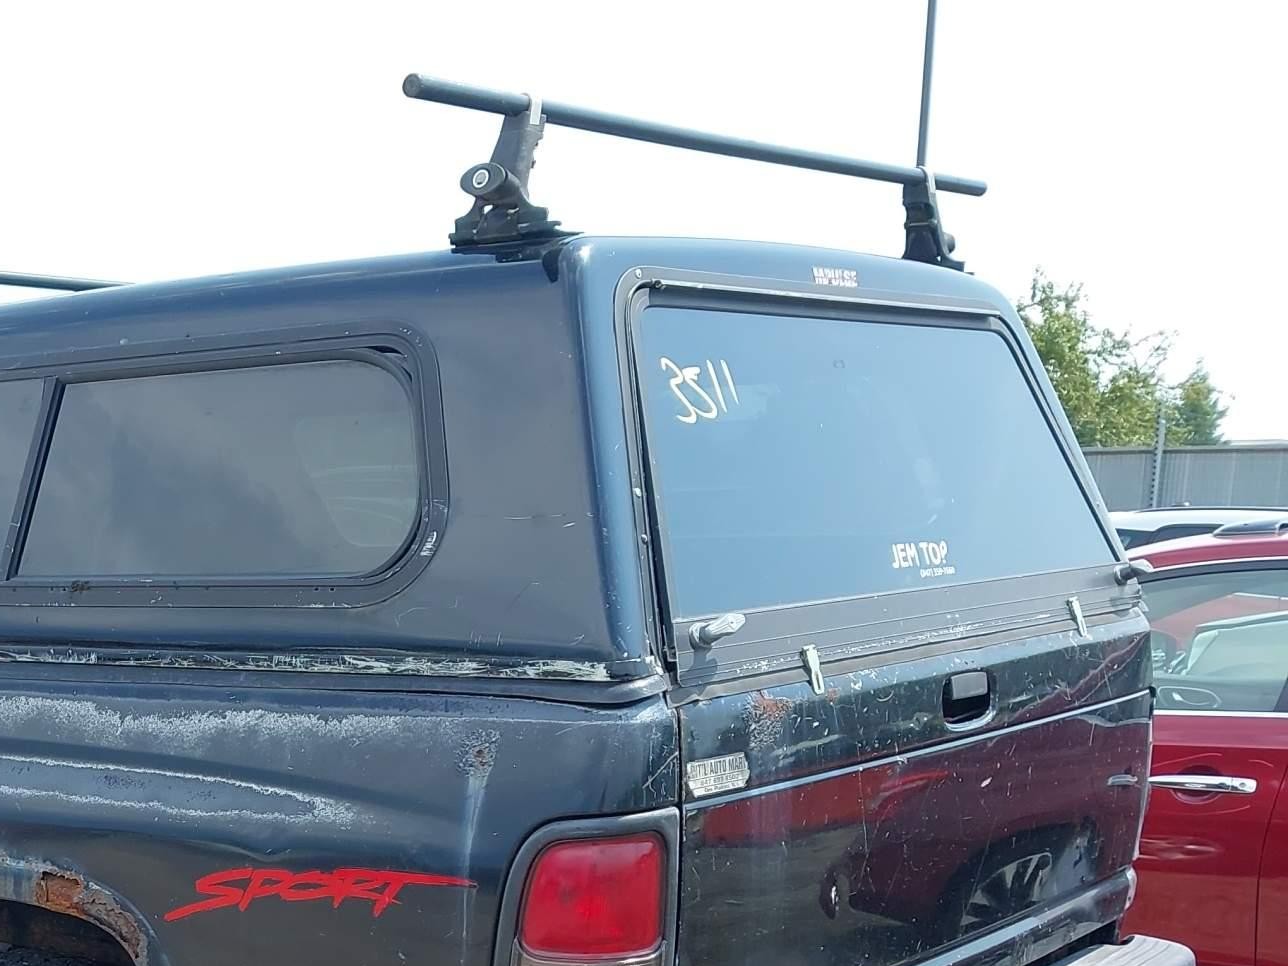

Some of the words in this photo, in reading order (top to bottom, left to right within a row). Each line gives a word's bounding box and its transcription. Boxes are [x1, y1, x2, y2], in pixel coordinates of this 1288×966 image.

[659, 356, 740, 424] 3511
[892, 542, 920, 569] JEM
[709, 759, 728, 776] AUTO
[163, 866, 477, 922] SPORT
